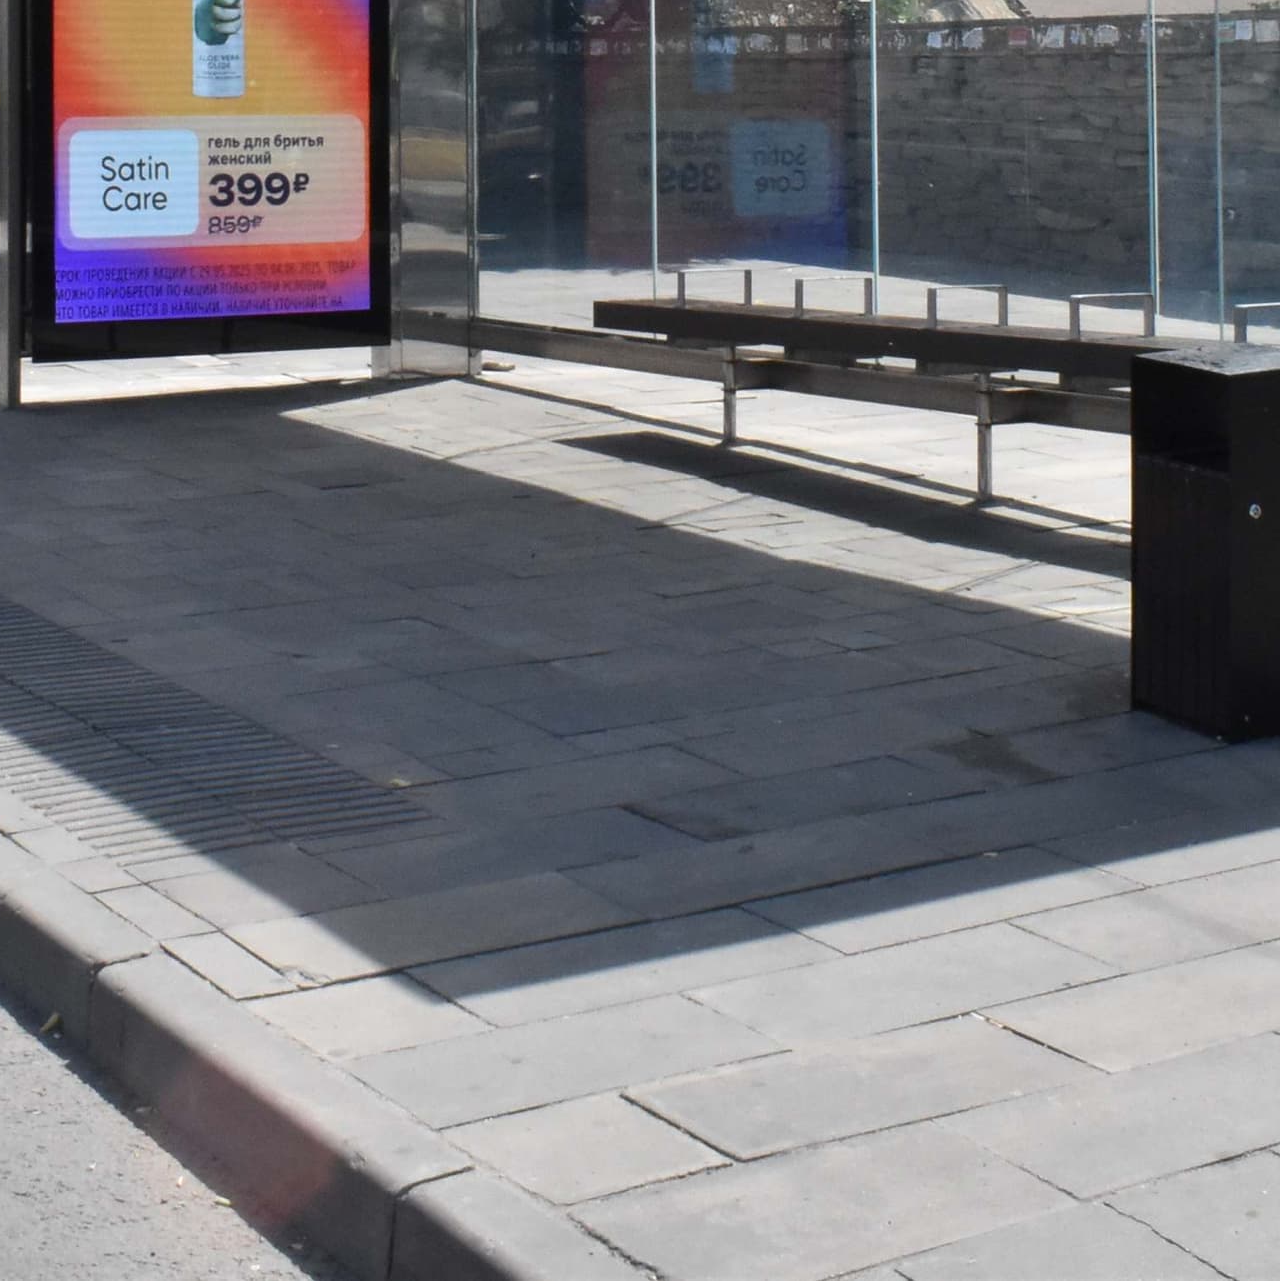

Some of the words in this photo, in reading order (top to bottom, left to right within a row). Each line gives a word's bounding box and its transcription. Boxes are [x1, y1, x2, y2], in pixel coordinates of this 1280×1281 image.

[207, 137, 240, 148] гель
[244, 136, 270, 150] для
[274, 134, 324, 150] бритья
[208, 151, 272, 166] женский
[101, 155, 169, 181] Satin
[102, 185, 168, 212] Care
[56, 269, 80, 283] СРОК
[56, 287, 95, 301] МОЖНО
[97, 285, 163, 300] ПРИОБРЕСТИ
[167, 284, 181, 297] ПО
[78, 305, 109, 319] ТОВАР
[112, 303, 158, 317] ИМЕЕТСЯ
[162, 303, 169, 315] В
